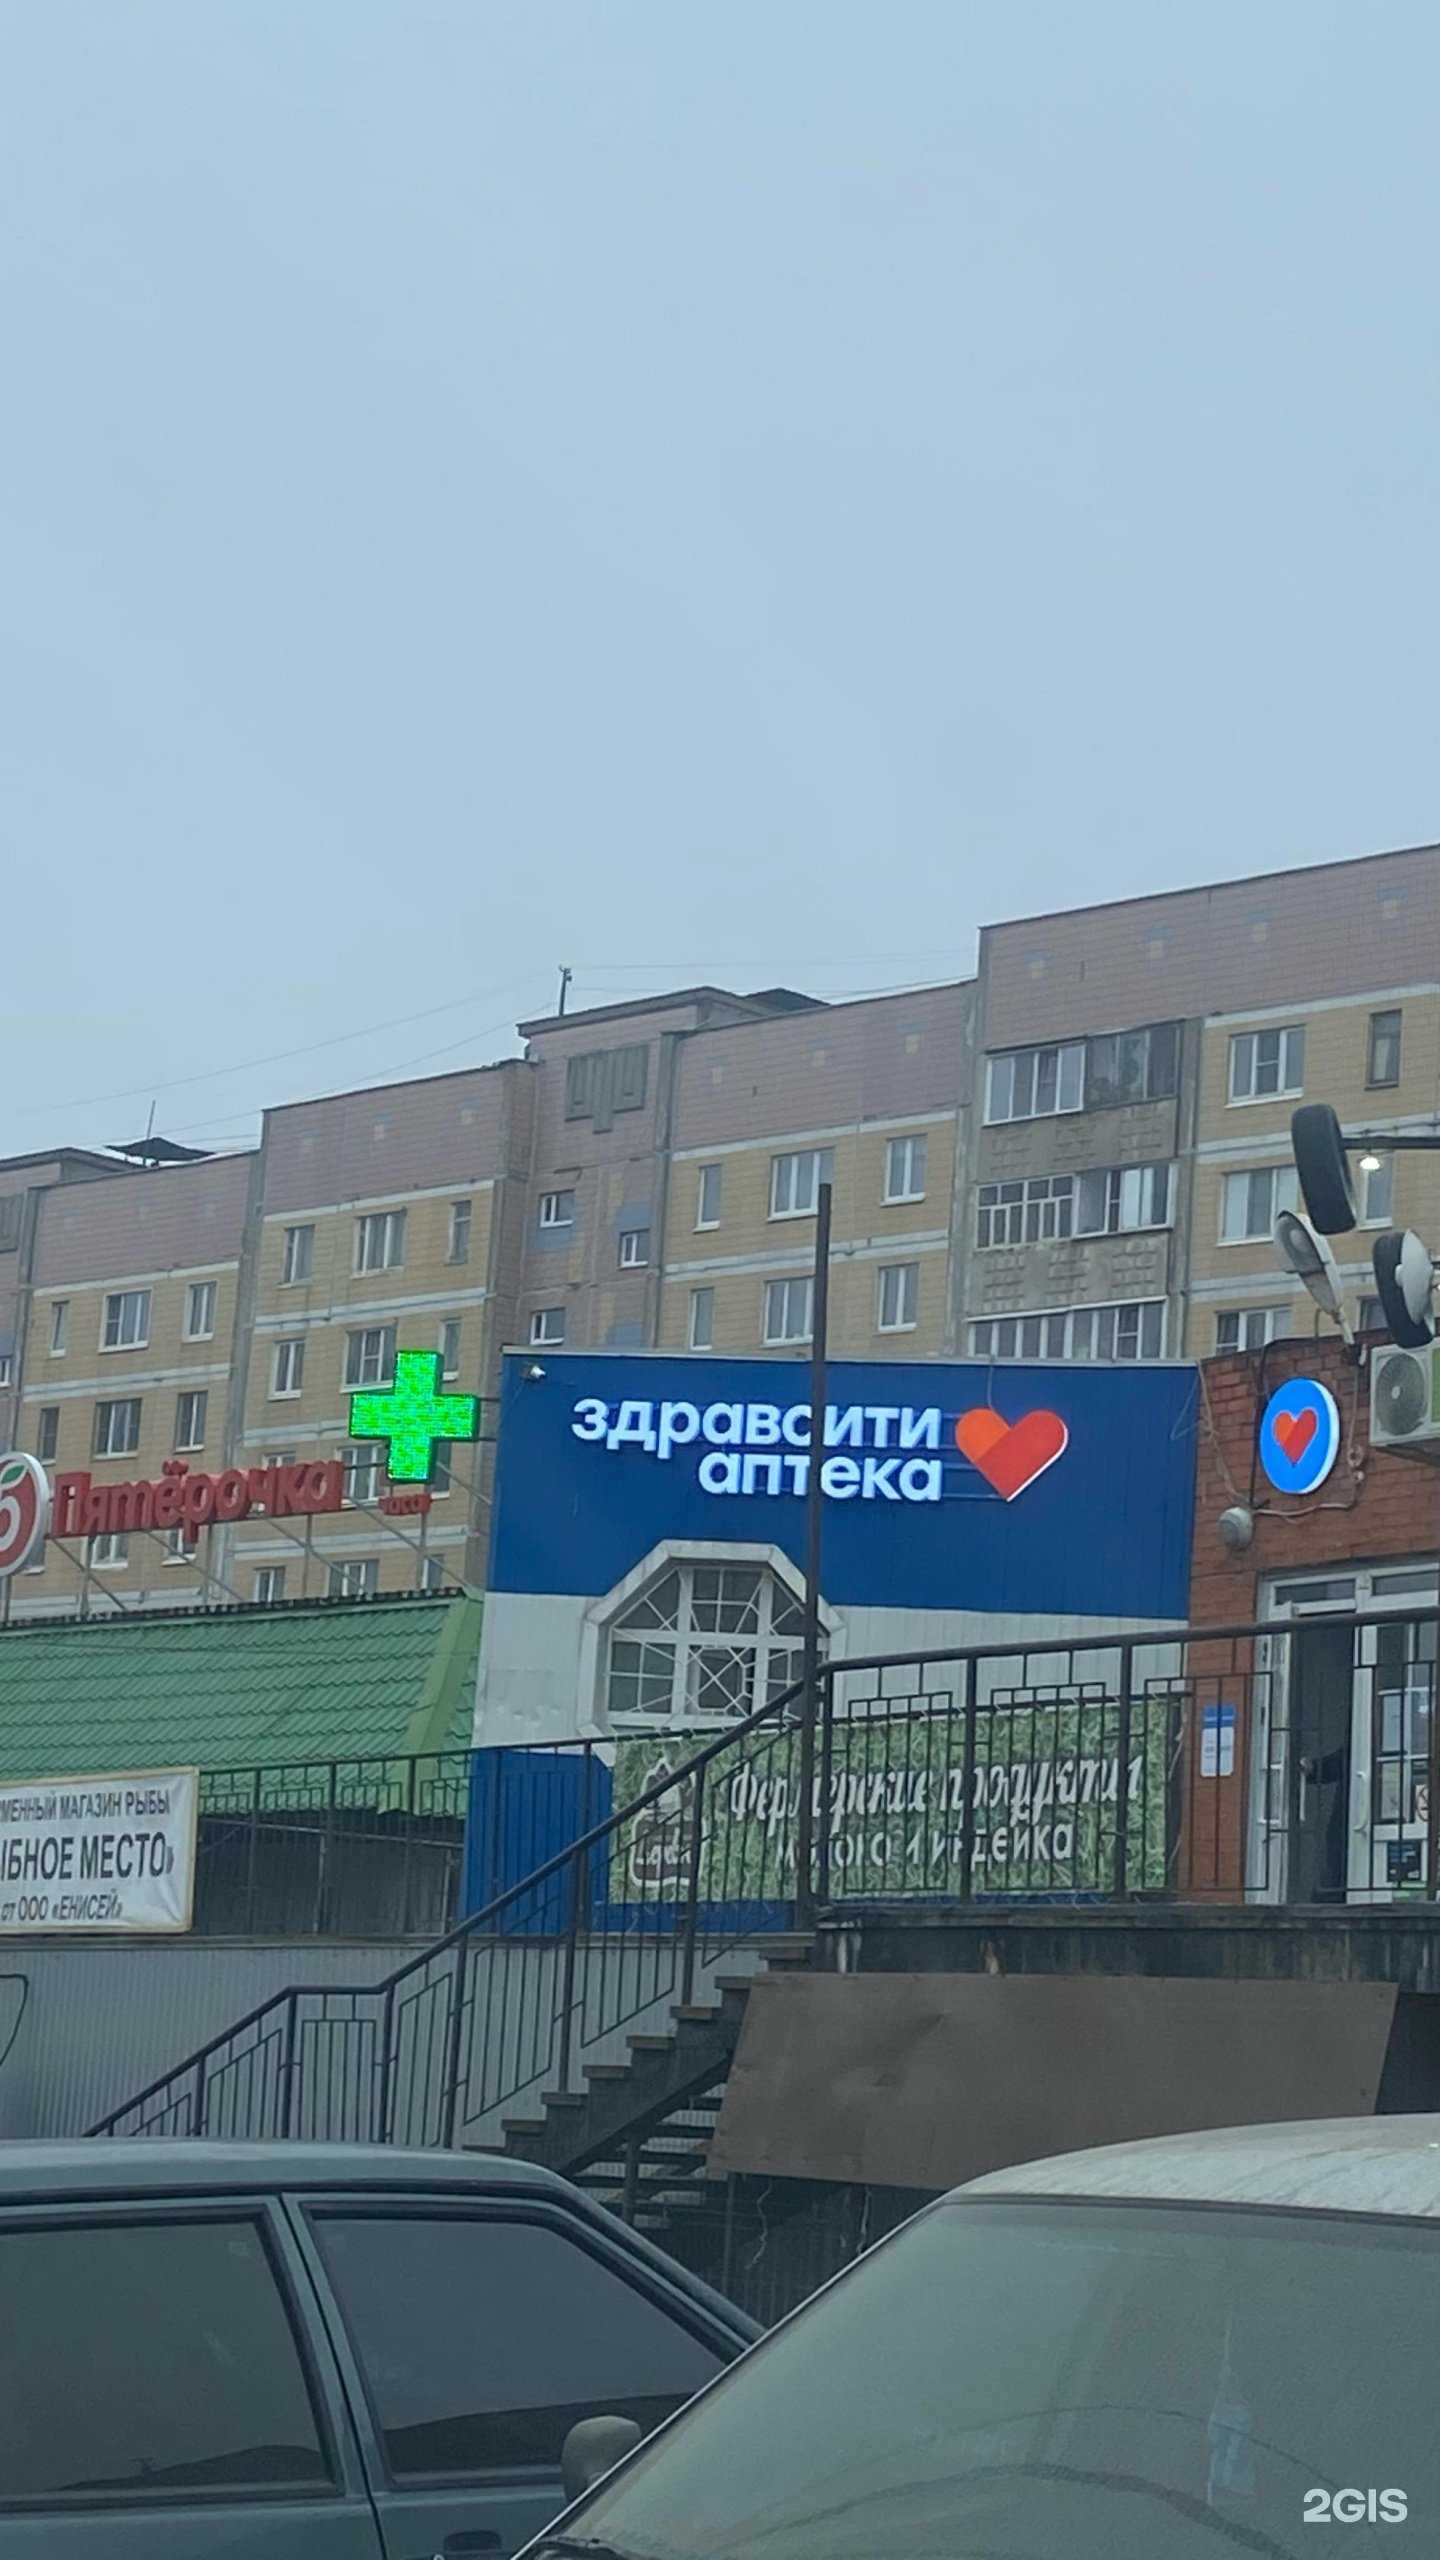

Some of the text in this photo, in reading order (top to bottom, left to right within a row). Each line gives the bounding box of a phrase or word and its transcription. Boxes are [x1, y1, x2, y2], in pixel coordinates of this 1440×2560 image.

[571, 1398, 942, 1459] здравсити
[699, 1452, 942, 1501] аптека
[54, 1460, 343, 1544] Пятёрочка
[60, 1791, 121, 1822] МАГАЗИН
[125, 1789, 171, 1817] РЫБЫ
[18, 1895, 49, 1921] ООО
